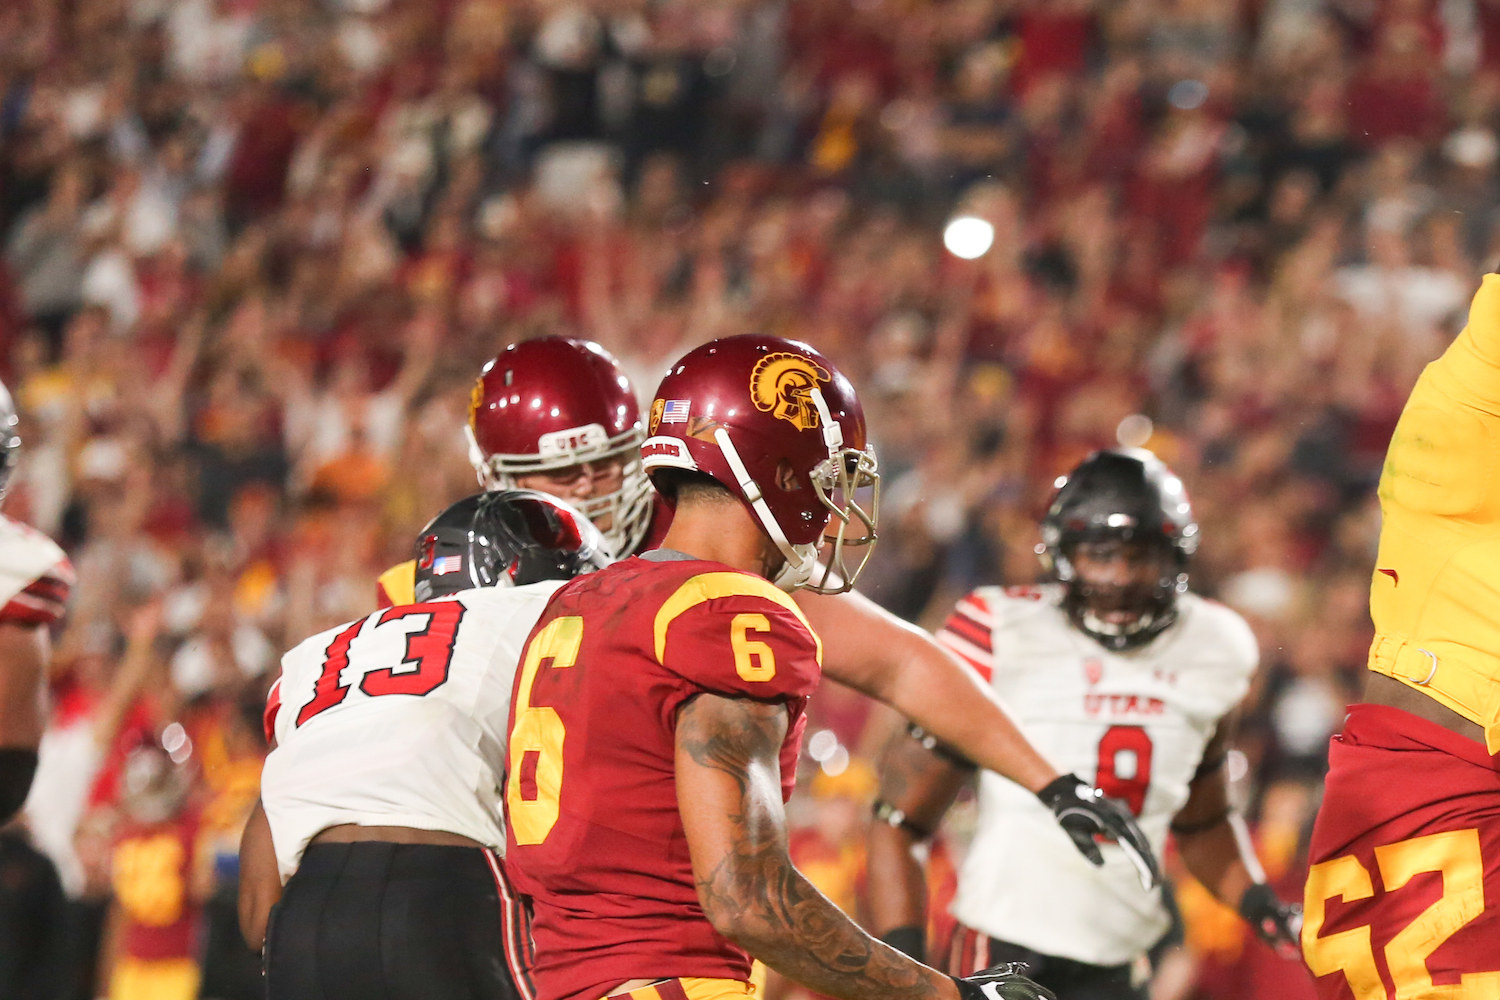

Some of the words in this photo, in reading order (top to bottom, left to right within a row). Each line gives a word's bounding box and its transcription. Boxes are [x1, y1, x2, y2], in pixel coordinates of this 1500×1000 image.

[555, 433, 589, 449] USC
[295, 600, 468, 729] 13
[730, 613, 776, 682] 6
[507, 615, 584, 846] 6
[1095, 724, 1154, 836] 9
